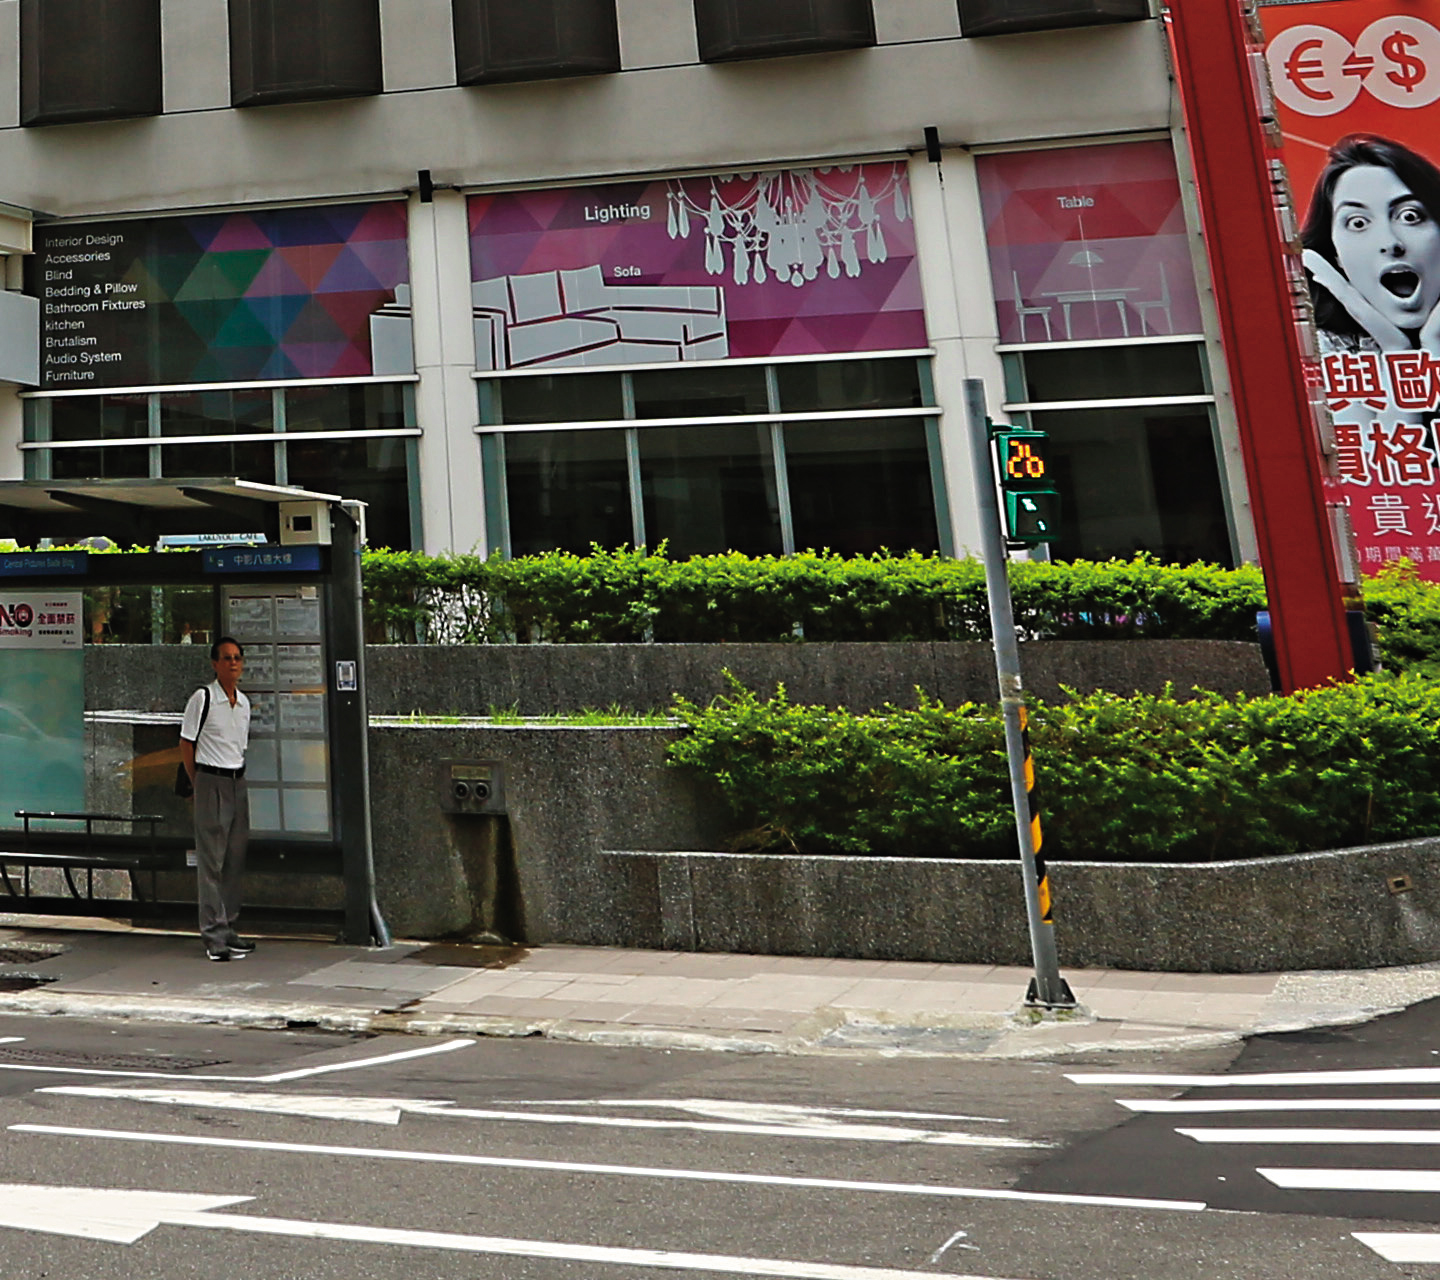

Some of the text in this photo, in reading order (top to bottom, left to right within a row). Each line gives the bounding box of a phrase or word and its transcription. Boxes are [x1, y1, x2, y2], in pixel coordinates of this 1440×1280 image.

[1057, 194, 1094, 208] Table
[584, 201, 651, 224] Lighting
[45, 234, 123, 247] Interior Design
[45, 251, 110, 264] Accessories
[45, 270, 72, 281] Blind
[613, 264, 642, 278] Sofa
[45, 283, 137, 298] Bedding & Pillow
[45, 300, 145, 314] Bathroom Fixtures
[45, 320, 84, 331] kitchen
[46, 336, 97, 347] Brutalism
[45, 352, 121, 365] Audio System
[46, 370, 94, 381] Furniture
[1008, 441, 1044, 477] 26
